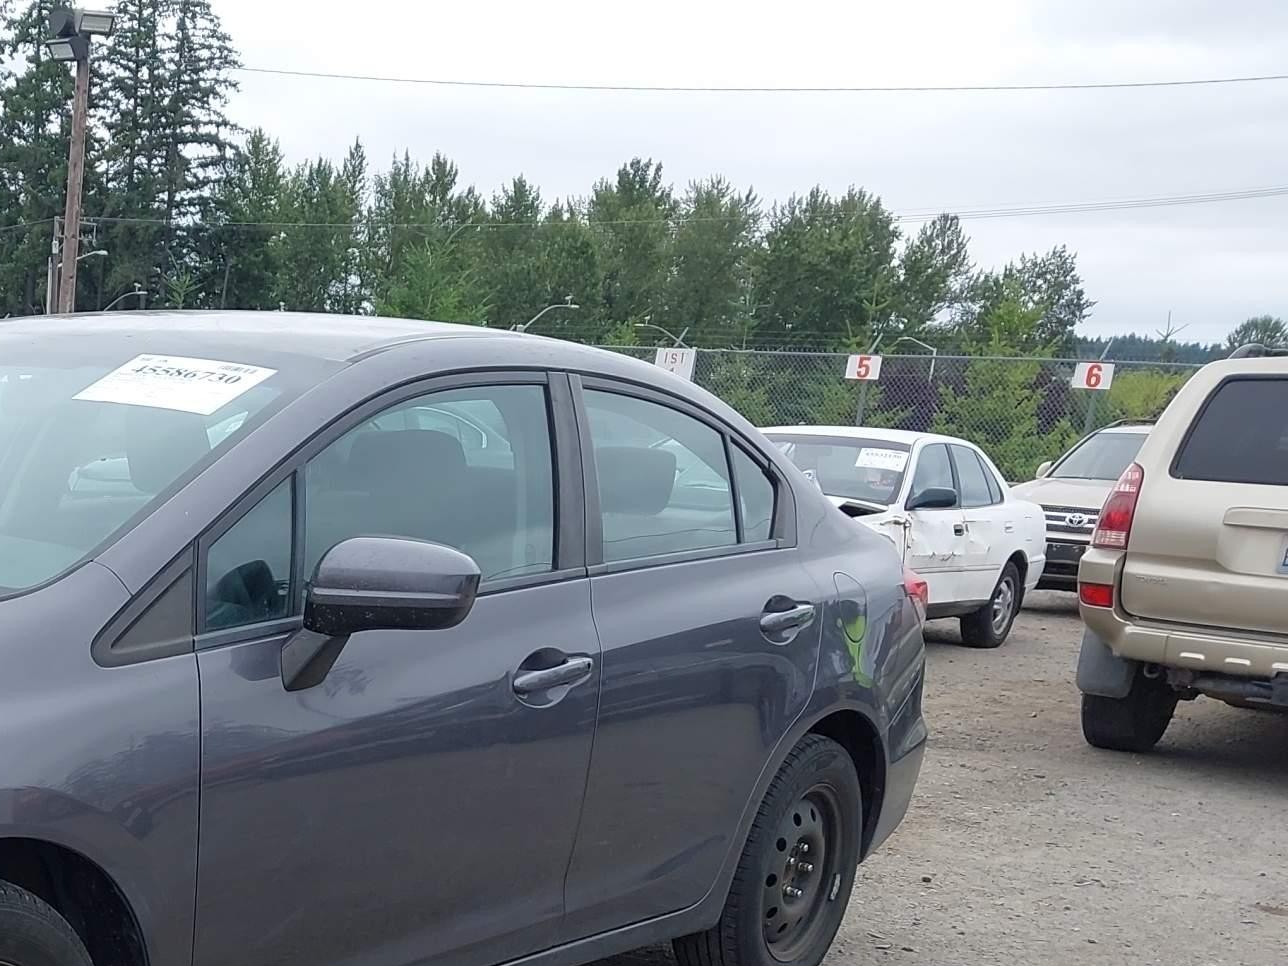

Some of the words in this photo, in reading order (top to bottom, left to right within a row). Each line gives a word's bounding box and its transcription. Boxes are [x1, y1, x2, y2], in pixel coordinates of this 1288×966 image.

[131, 364, 242, 385] 45586730
[856, 356, 872, 378] 5
[1085, 364, 1103, 388] 6
